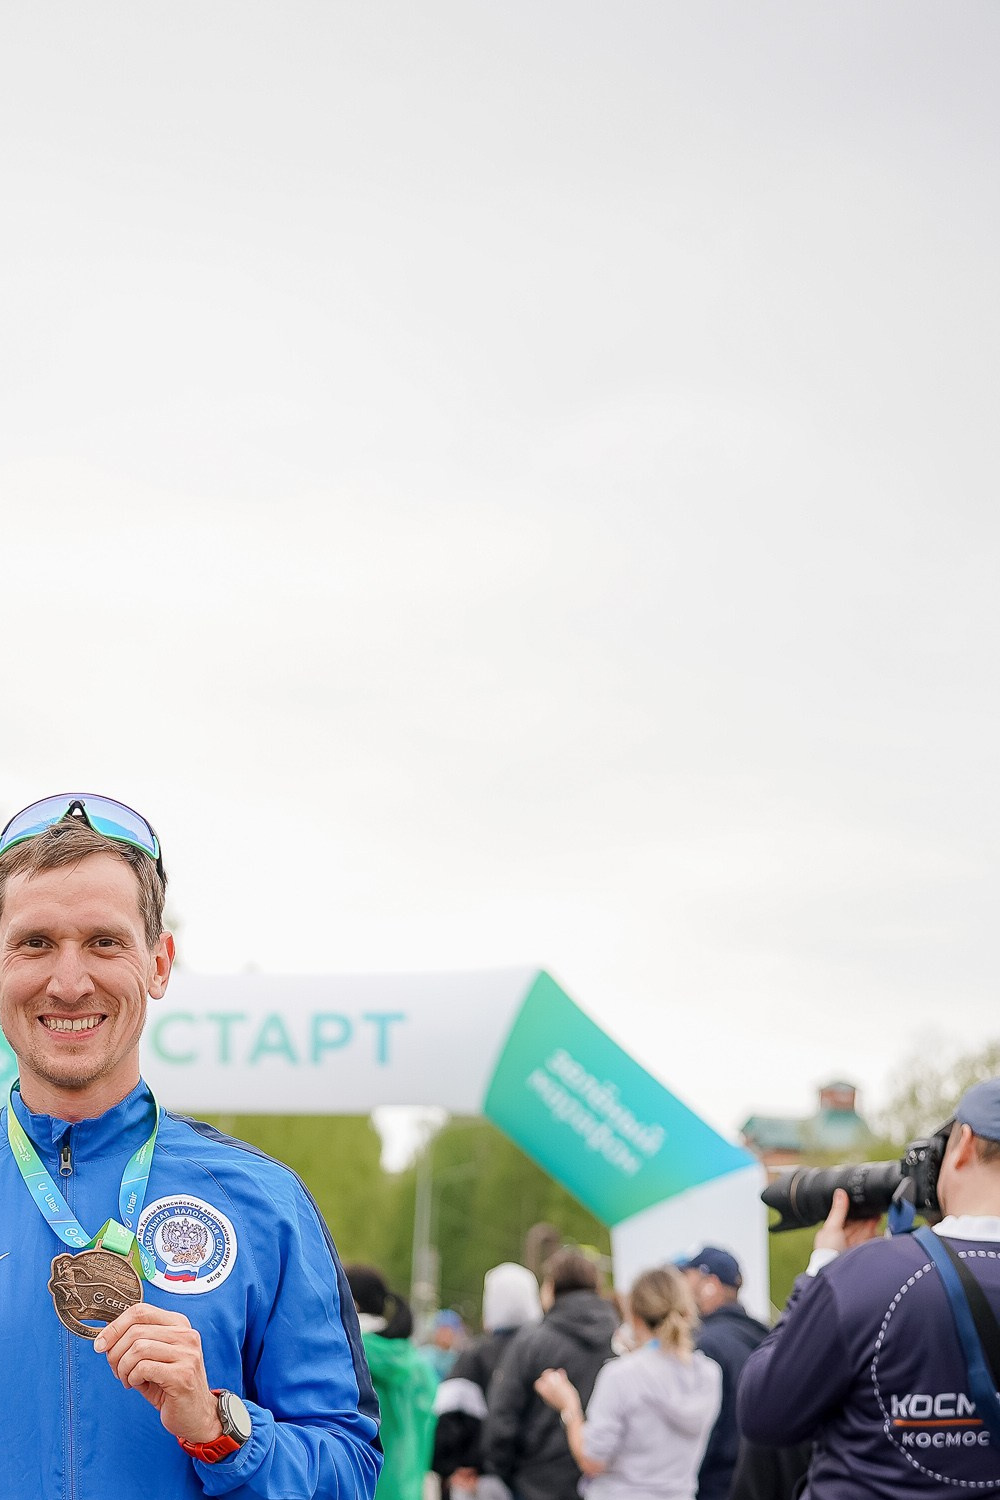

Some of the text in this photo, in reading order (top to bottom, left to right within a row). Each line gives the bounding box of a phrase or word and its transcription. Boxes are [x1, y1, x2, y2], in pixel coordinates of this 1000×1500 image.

[150, 1011, 406, 1066] СТАРТ
[126, 1192, 138, 1214] Utair
[141, 1200, 203, 1228] Ханты-Мансийскому
[174, 1208, 220, 1235] НАЛОГОВАЯ
[208, 1239, 223, 1269] СЛУЖБА
[203, 1208, 230, 1244] автономному
[222, 1244, 230, 1268] округу
[206, 1272, 222, 1284] Югре
[891, 1393, 978, 1418] КОСМ
[902, 1431, 991, 1448] КОСМОС
